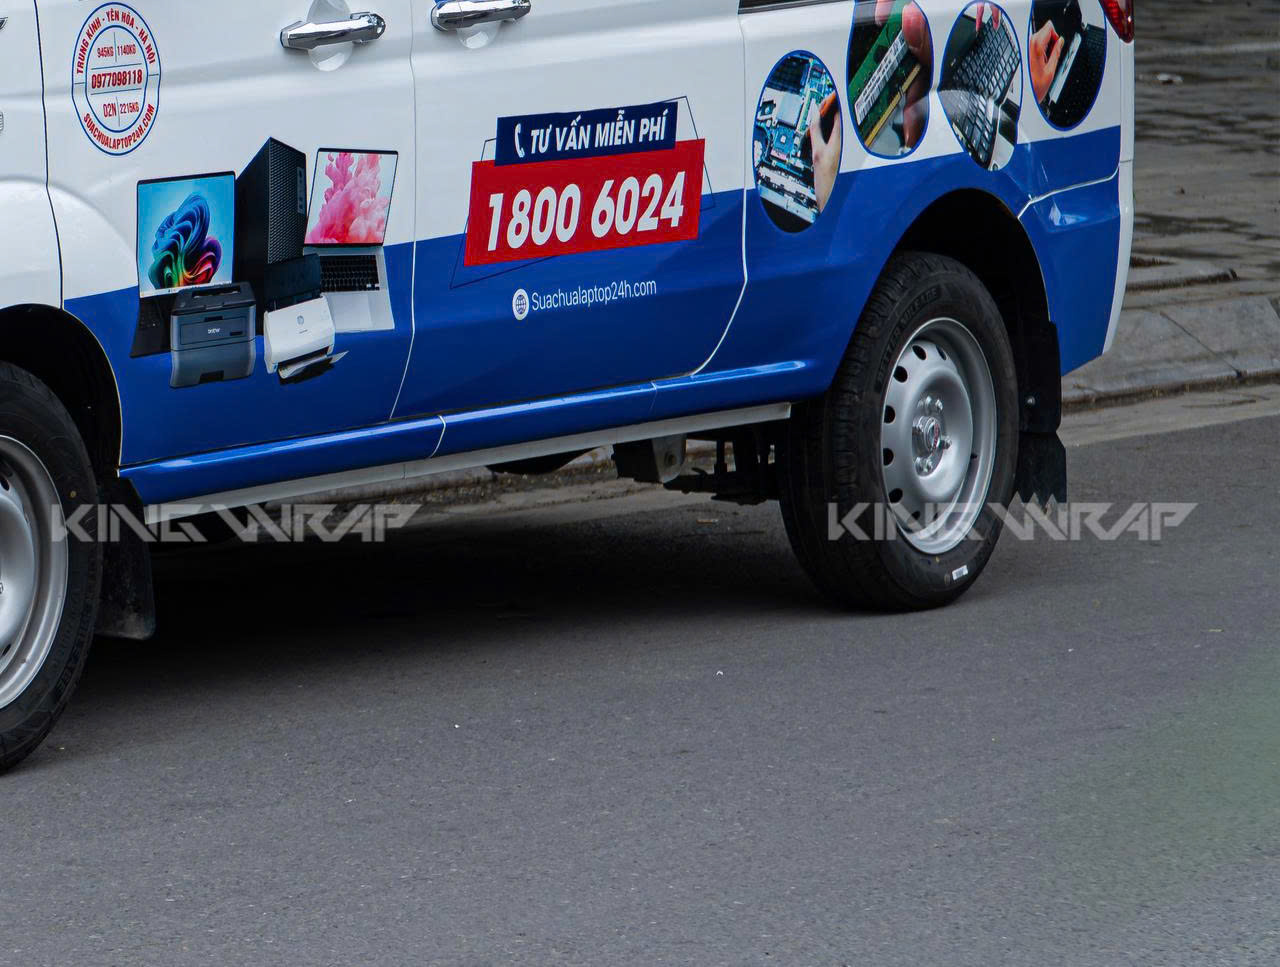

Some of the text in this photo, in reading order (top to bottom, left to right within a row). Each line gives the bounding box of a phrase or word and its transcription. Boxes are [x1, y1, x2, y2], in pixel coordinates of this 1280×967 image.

[77, 39, 89, 74] TRUNG
[86, 17, 102, 40] KÍNH
[106, 8, 120, 22] YÊN
[91, 69, 143, 89] 0977098118
[83, 104, 155, 150] SUACHUALAPTOP24H.COM
[531, 109, 669, 154] TƯ VẤN MIỄN PHÍ
[487, 171, 686, 251] 1800 6024
[531, 279, 657, 311] Suachualaptop24h.com
